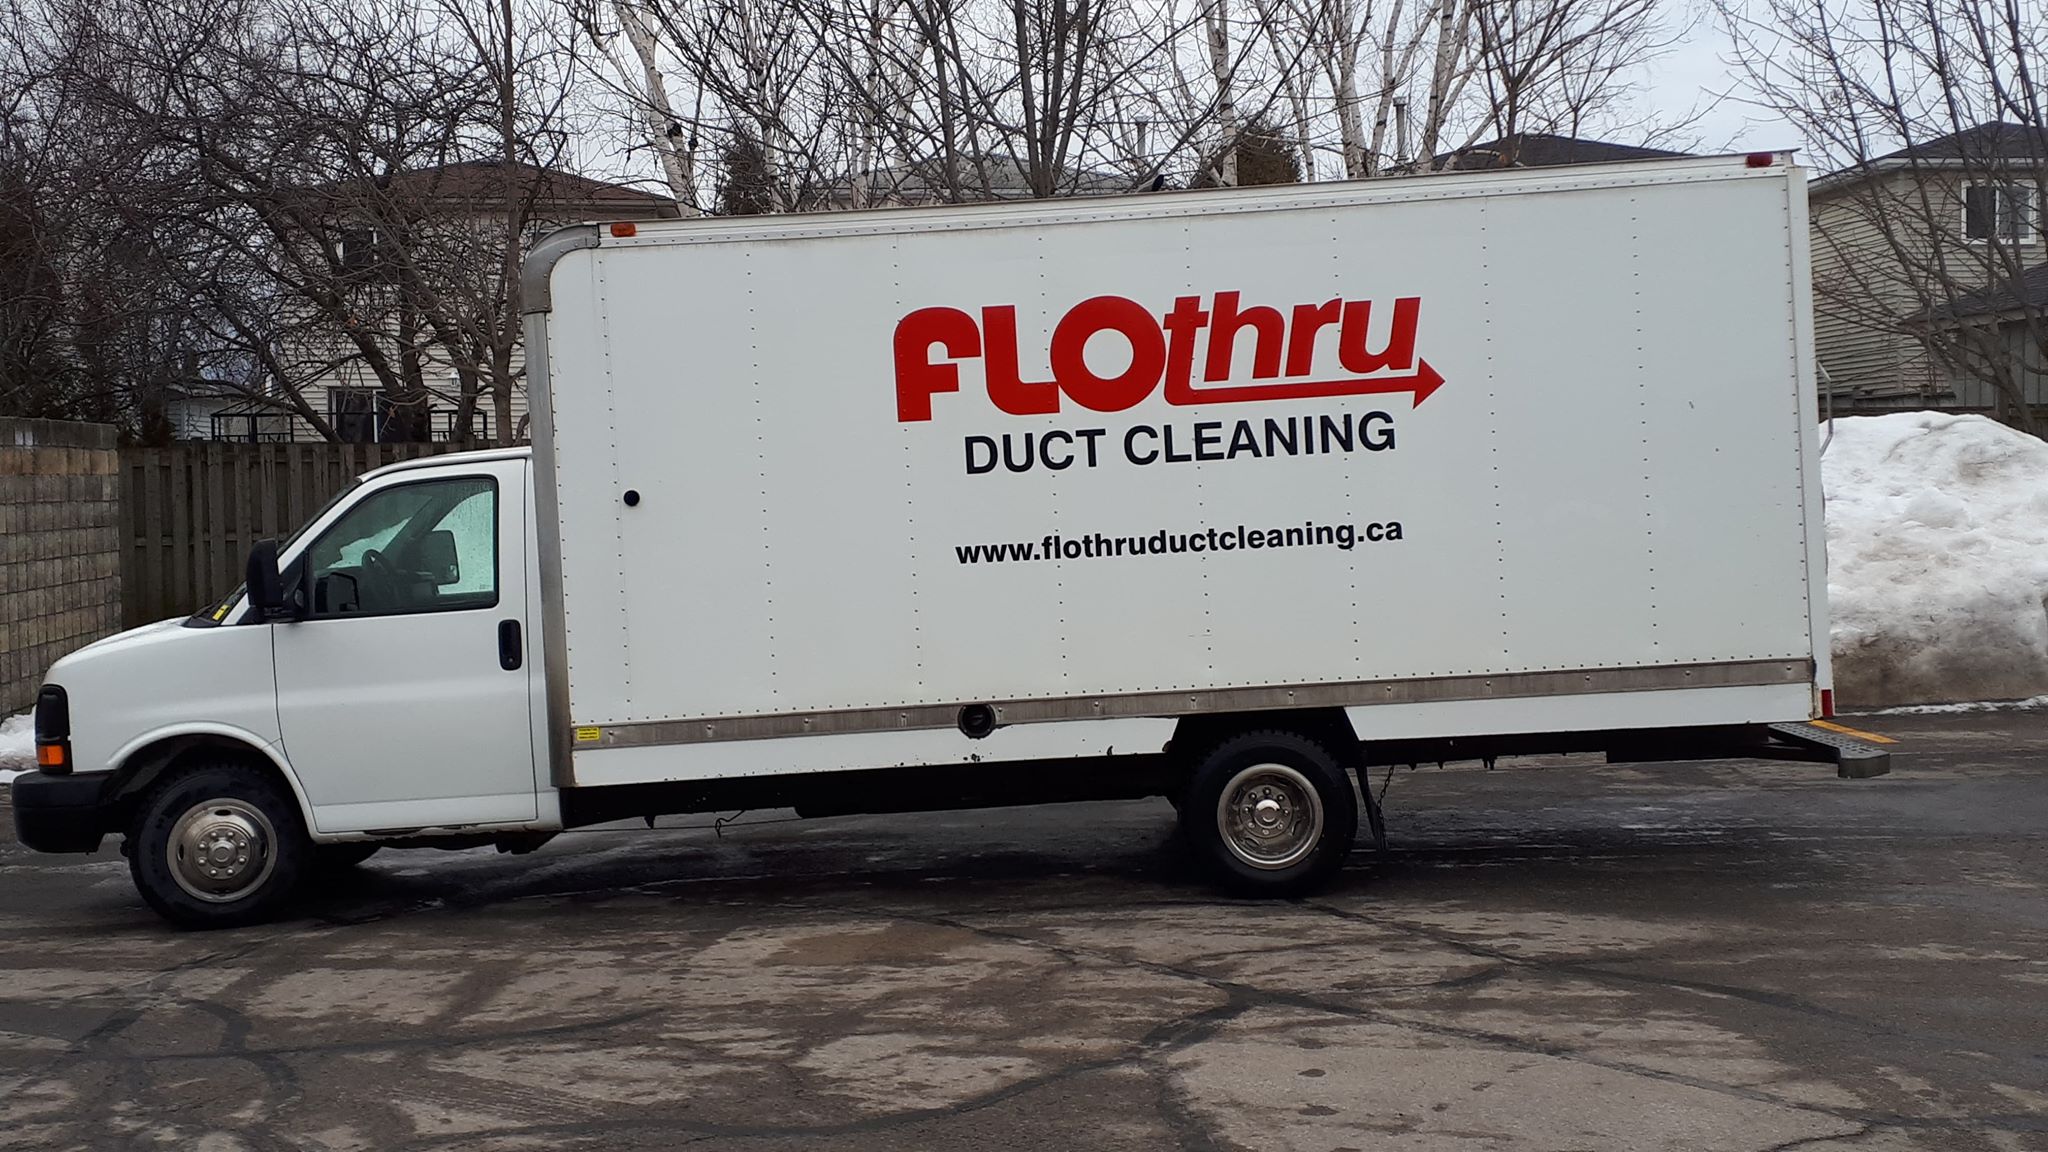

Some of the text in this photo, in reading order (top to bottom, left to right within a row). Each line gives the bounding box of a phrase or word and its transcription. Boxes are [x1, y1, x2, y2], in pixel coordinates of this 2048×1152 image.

[964, 410, 1396, 475] DUCT CLEANING
[955, 520, 1403, 565] www.flothruductcleaning.ca
